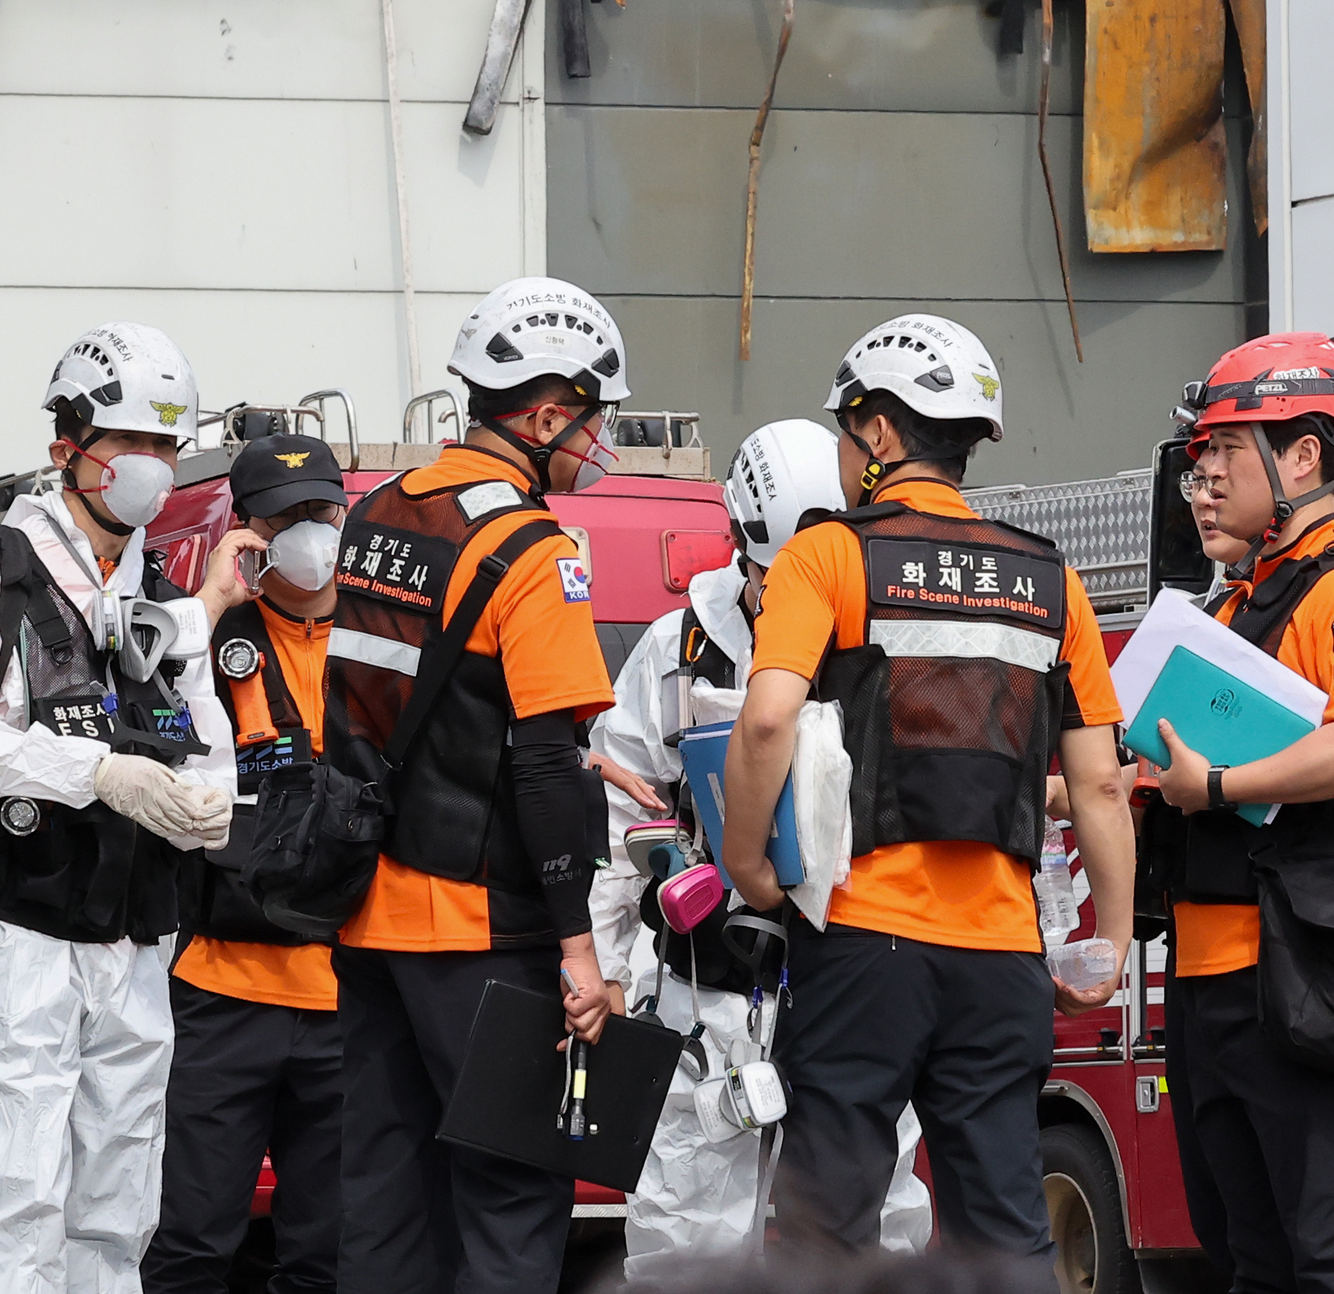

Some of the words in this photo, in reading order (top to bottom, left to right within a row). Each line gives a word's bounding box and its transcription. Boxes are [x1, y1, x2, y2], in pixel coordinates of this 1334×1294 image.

[572, 297, 611, 329] 화재조사
[911, 322, 954, 347] 화재조사
[1256, 384, 1288, 394] PETZL
[369, 534, 411, 557] 경기도
[342, 546, 428, 591] 화재조사
[938, 551, 998, 570] 경기도
[343, 572, 369, 589] Scene
[371, 579, 432, 607] Investigation
[901, 562, 1036, 602] 화재조사
[887, 585, 915, 599] Fire
[919, 588, 960, 604] Scene
[963, 594, 1048, 618] Investigation
[543, 854, 572, 872] 119
